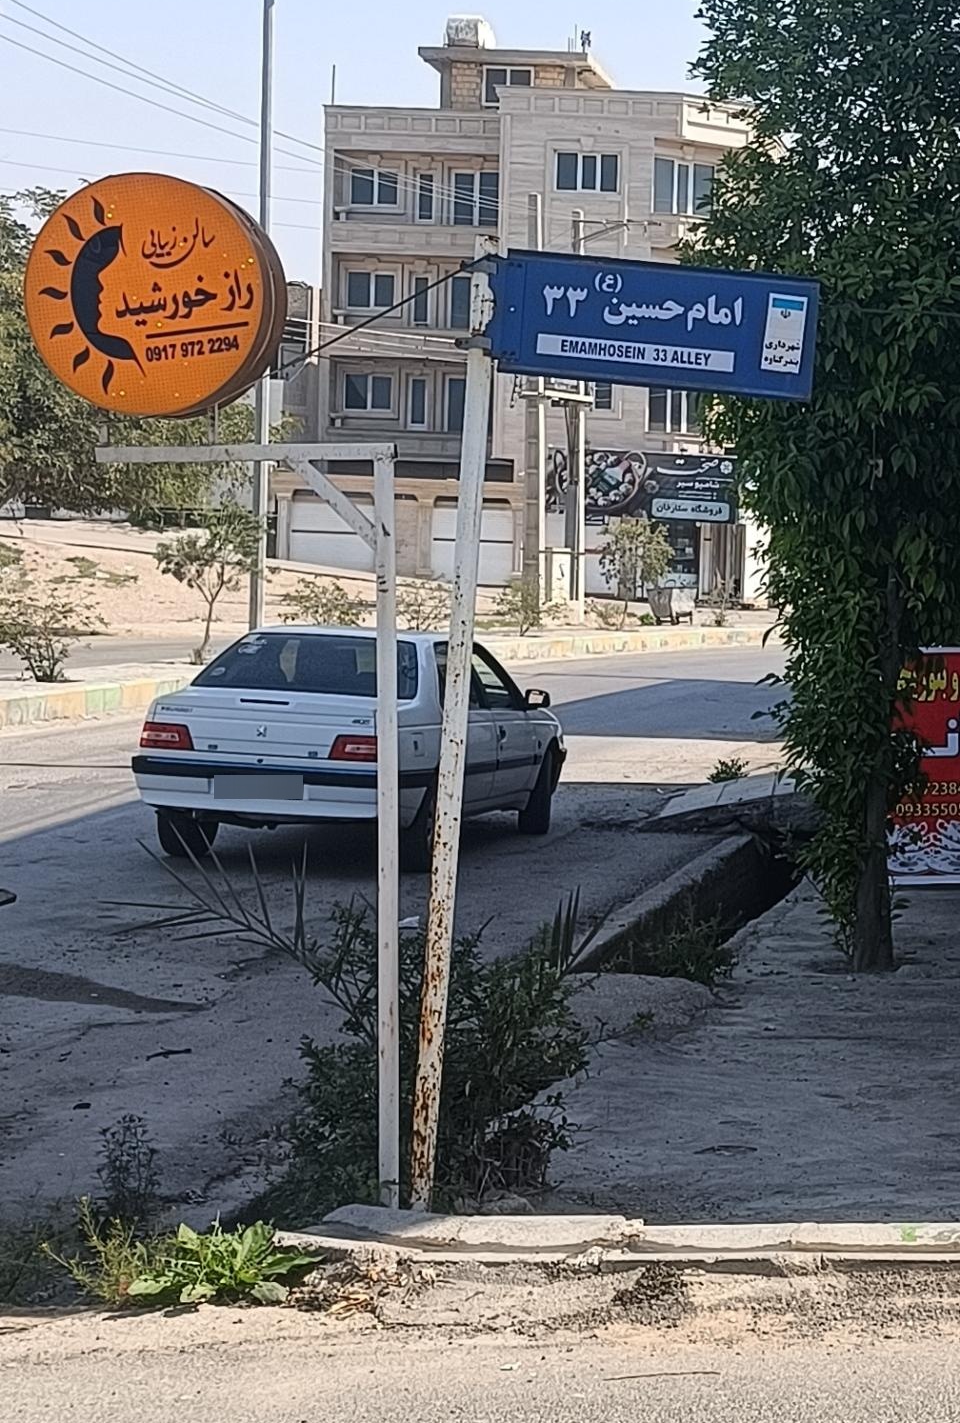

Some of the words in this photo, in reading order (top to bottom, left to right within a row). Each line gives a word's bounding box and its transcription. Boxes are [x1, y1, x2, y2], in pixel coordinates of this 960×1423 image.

[142, 226, 177, 260] زیبایی
[149, 217, 216, 269] سالن
[220, 269, 254, 311] راز
[594, 272, 623, 294] (ع)
[115, 274, 217, 326] خورشید
[542, 284, 588, 318] ۳۳
[603, 297, 685, 326] حسین
[687, 294, 743, 332] امام
[145, 342, 176, 363] 0917
[180, 339, 205, 358] 972
[208, 335, 240, 355] 2294
[560, 339, 646, 361] EMAMHOSEIN
[652, 348, 668, 363] 33
[671, 350, 712, 367] ALLEY
[765, 339, 800, 352] شهرداری
[656, 502, 688, 514] ستارخان
[691, 504, 723, 516] فروشگاه
[950, 672, 959, 701] و
